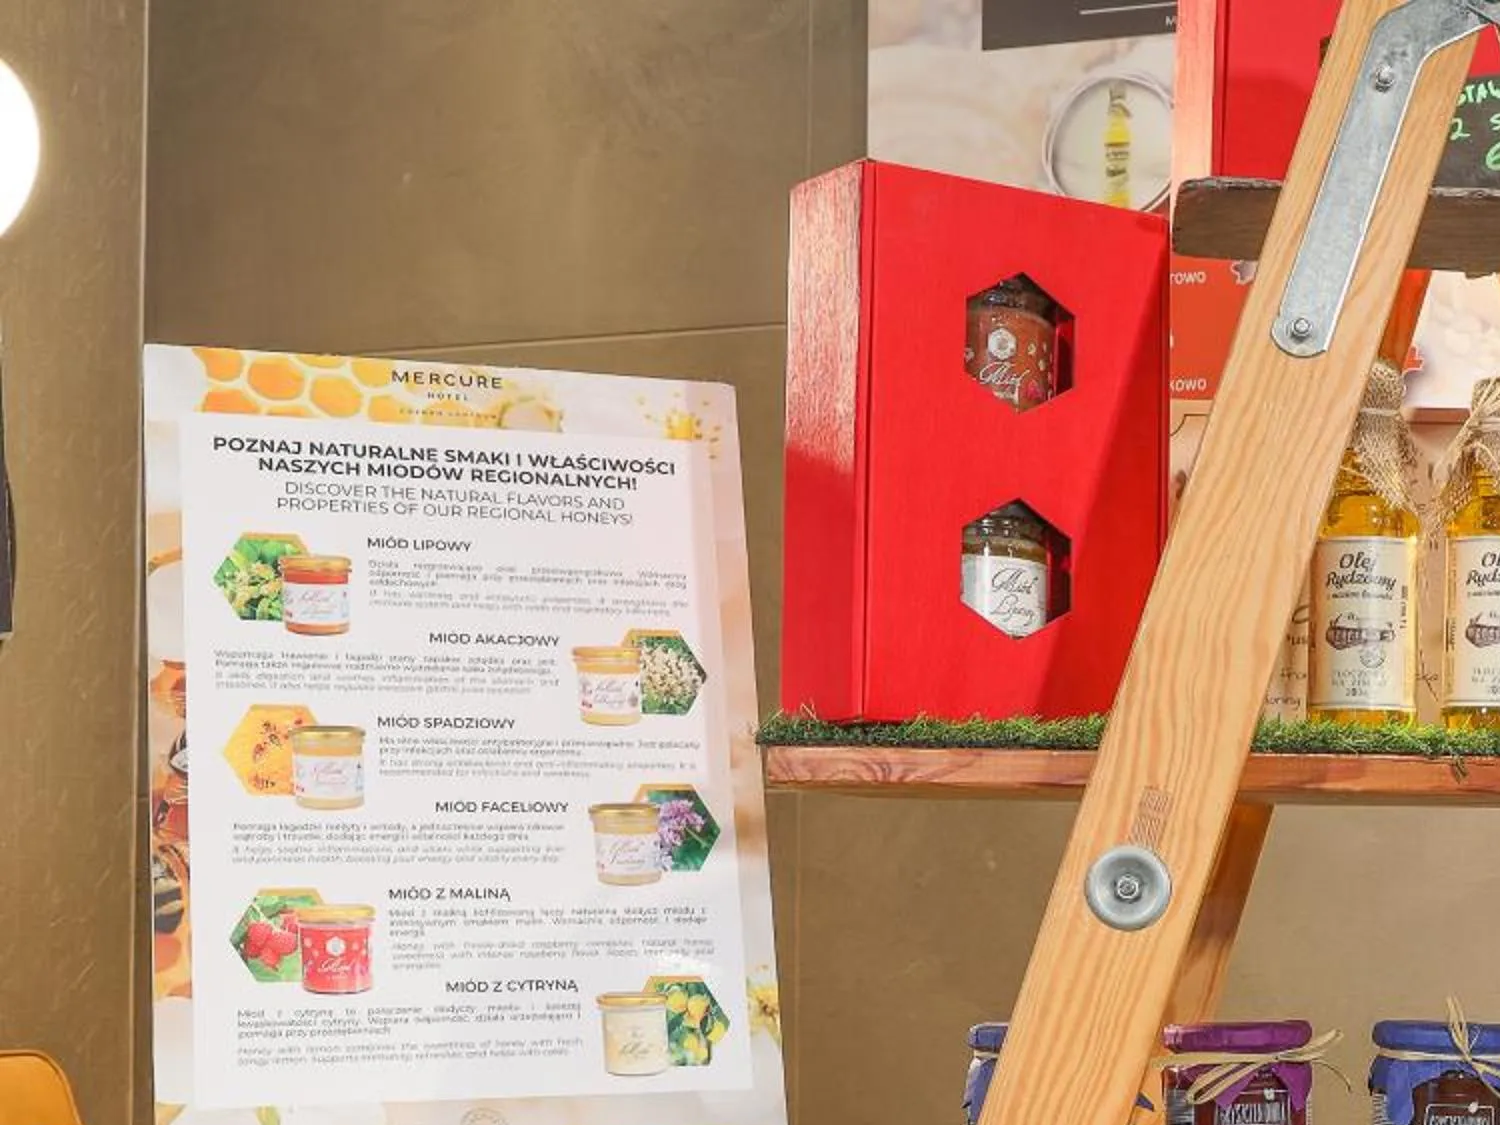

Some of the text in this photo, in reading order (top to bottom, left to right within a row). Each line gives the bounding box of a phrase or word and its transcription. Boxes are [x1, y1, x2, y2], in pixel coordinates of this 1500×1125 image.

[1450, 117, 1471, 141] 2
[391, 370, 503, 389] MERCURE
[213, 436, 676, 476] POZNAJ NATURALNE SMAKI I WŁAŚCIWOŚCI
[258, 457, 638, 491] NASZYCH MIODÓW REGIONALNYCH!
[285, 481, 625, 511] DISCOVER THE NATURAL FLAVORS AND
[277, 497, 633, 525] PROPERTIES OF OUR REGIONAL HONEYS!
[367, 536, 472, 552] MIÓD LIPOWY
[1339, 551, 1377, 573] Olej
[475, 633, 561, 648] AKACJOWY
[377, 714, 516, 730] MIÓD SPADZIOWY
[481, 801, 569, 814] FACELIOWY
[389, 886, 511, 902] MIÓD Z MALINĄ
[445, 979, 579, 994] MIÓD Z CYTRYNĄ
